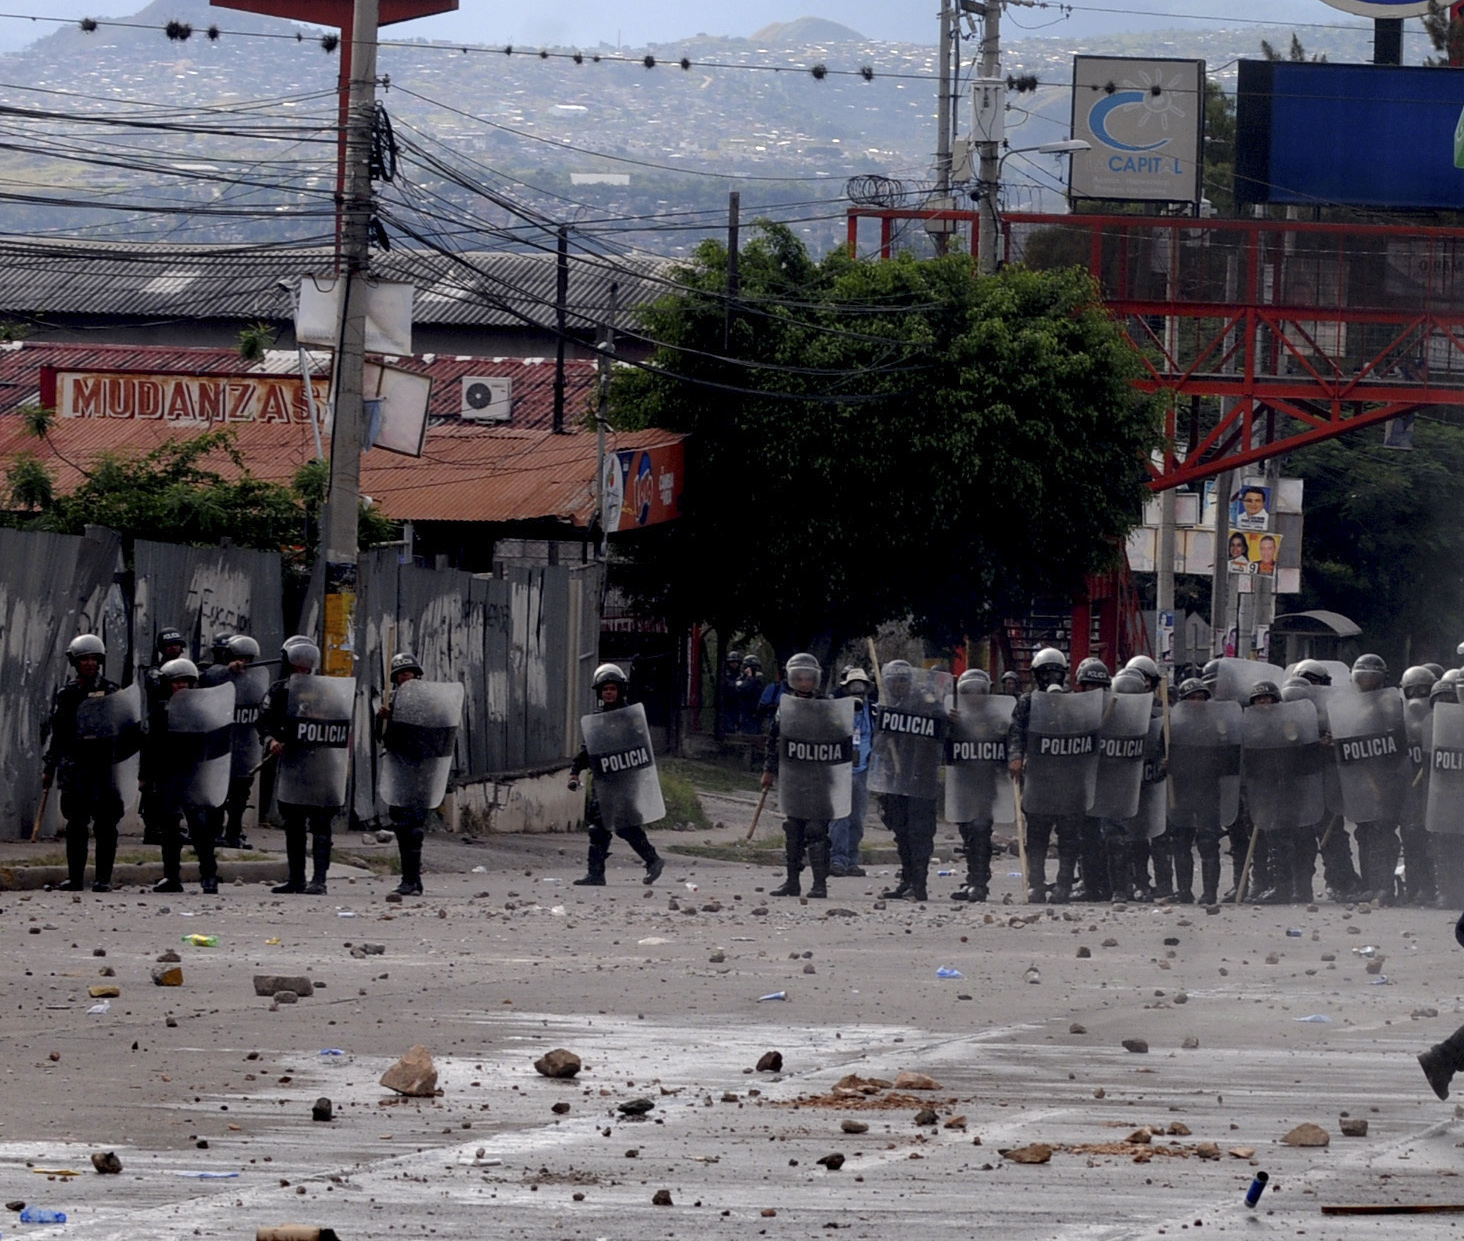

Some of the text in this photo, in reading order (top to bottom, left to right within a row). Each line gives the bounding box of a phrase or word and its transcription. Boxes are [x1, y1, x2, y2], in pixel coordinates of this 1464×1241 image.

[71, 378, 326, 424] MUDANZAS
[297, 722, 347, 743] POLICIA
[881, 711, 936, 737] POLICIA
[788, 741, 843, 761] POLICIA
[953, 741, 1006, 761] POLICIA
[1040, 735, 1093, 756] POLICIA
[1100, 739, 1144, 758] POLICIA
[1342, 736, 1398, 760] POLICIA
[600, 747, 650, 773] POLICIA
